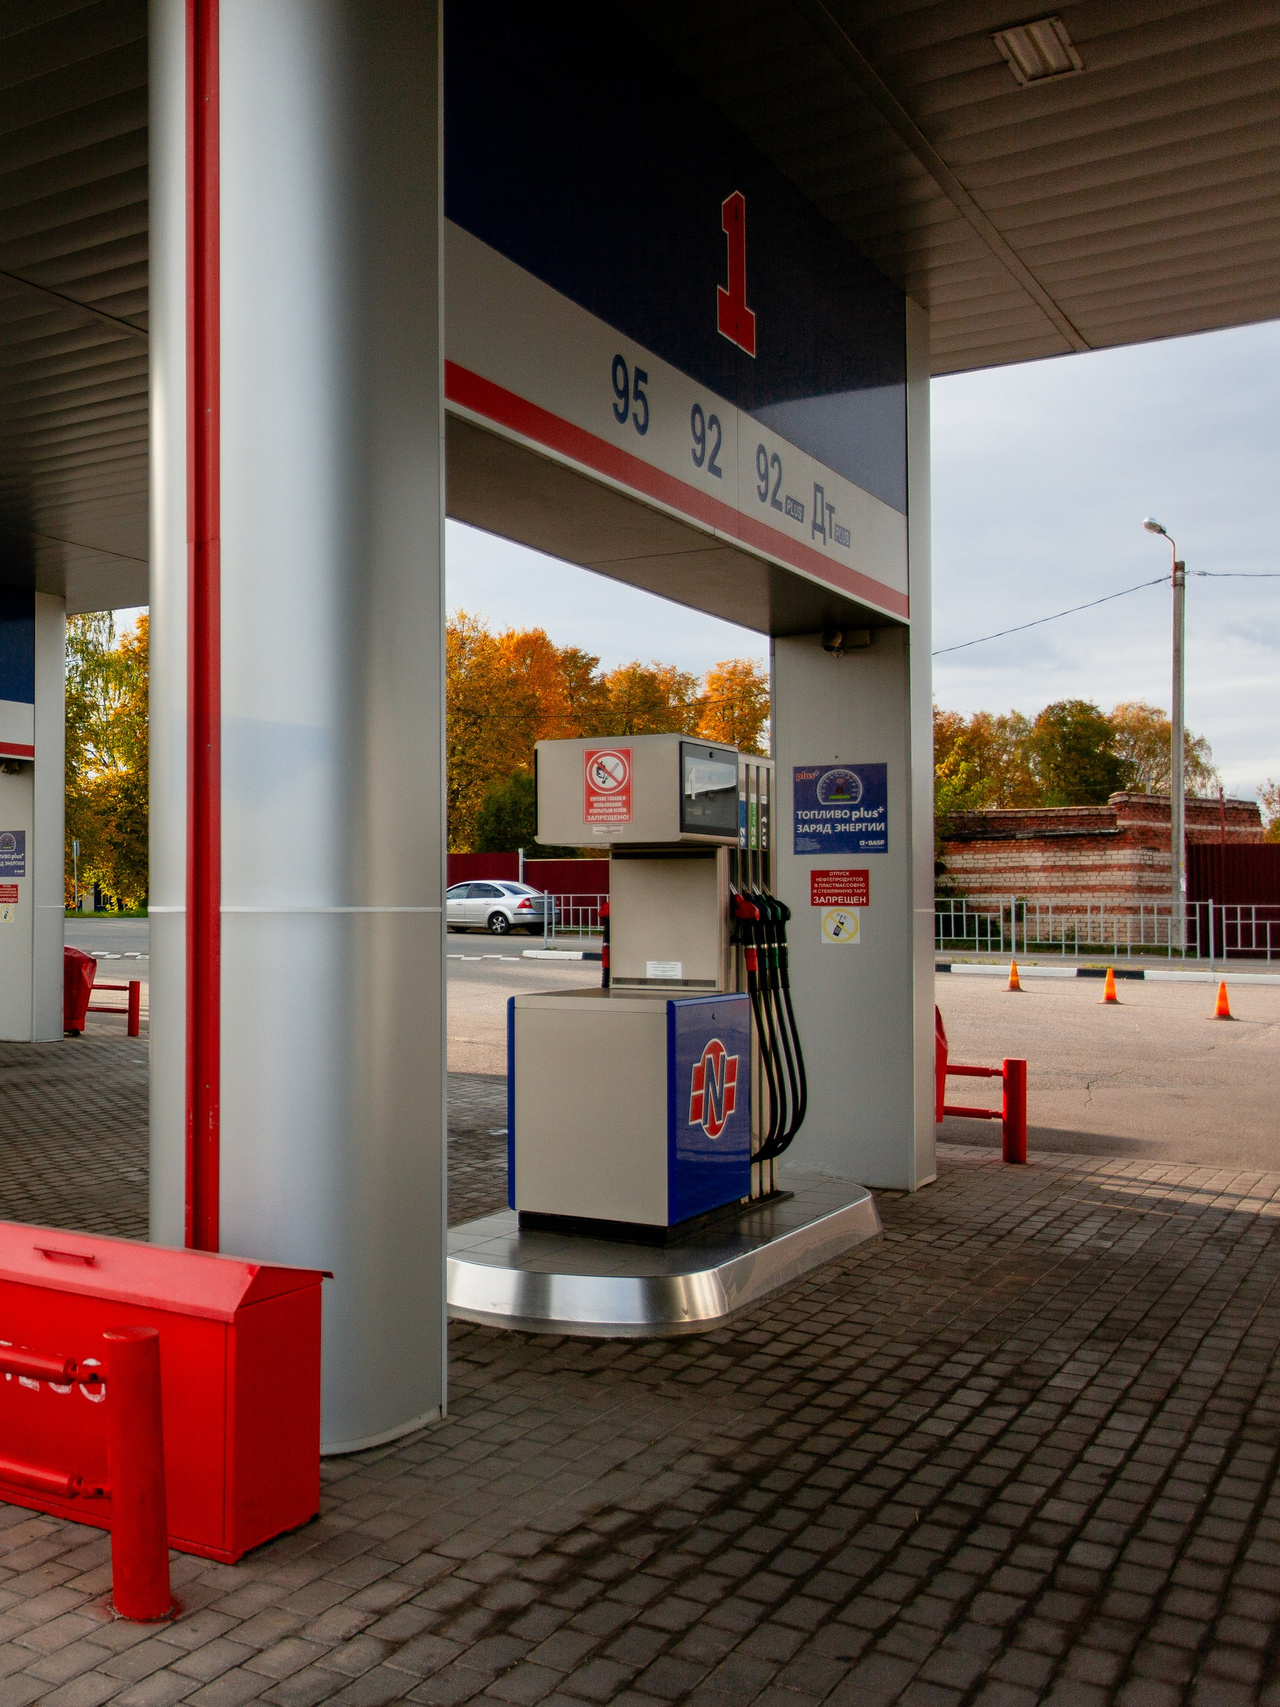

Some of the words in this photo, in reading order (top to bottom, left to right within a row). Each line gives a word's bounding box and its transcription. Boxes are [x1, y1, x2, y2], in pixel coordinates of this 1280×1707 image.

[717, 190, 756, 359] 1
[611, 353, 649, 436] 95
[690, 403, 722, 479] 92
[756, 443, 783, 513] 92
[785, 497, 804, 523] PLUS
[835, 525, 850, 548] PLUS
[689, 767, 696, 800] 1
[796, 809, 850, 819] ТОПЛИВО
[796, 824, 832, 834] ЗАРЯД
[834, 822, 885, 832] ЭНЕРГИИ
[813, 896, 866, 904] ЗАПРЕЩЕН
